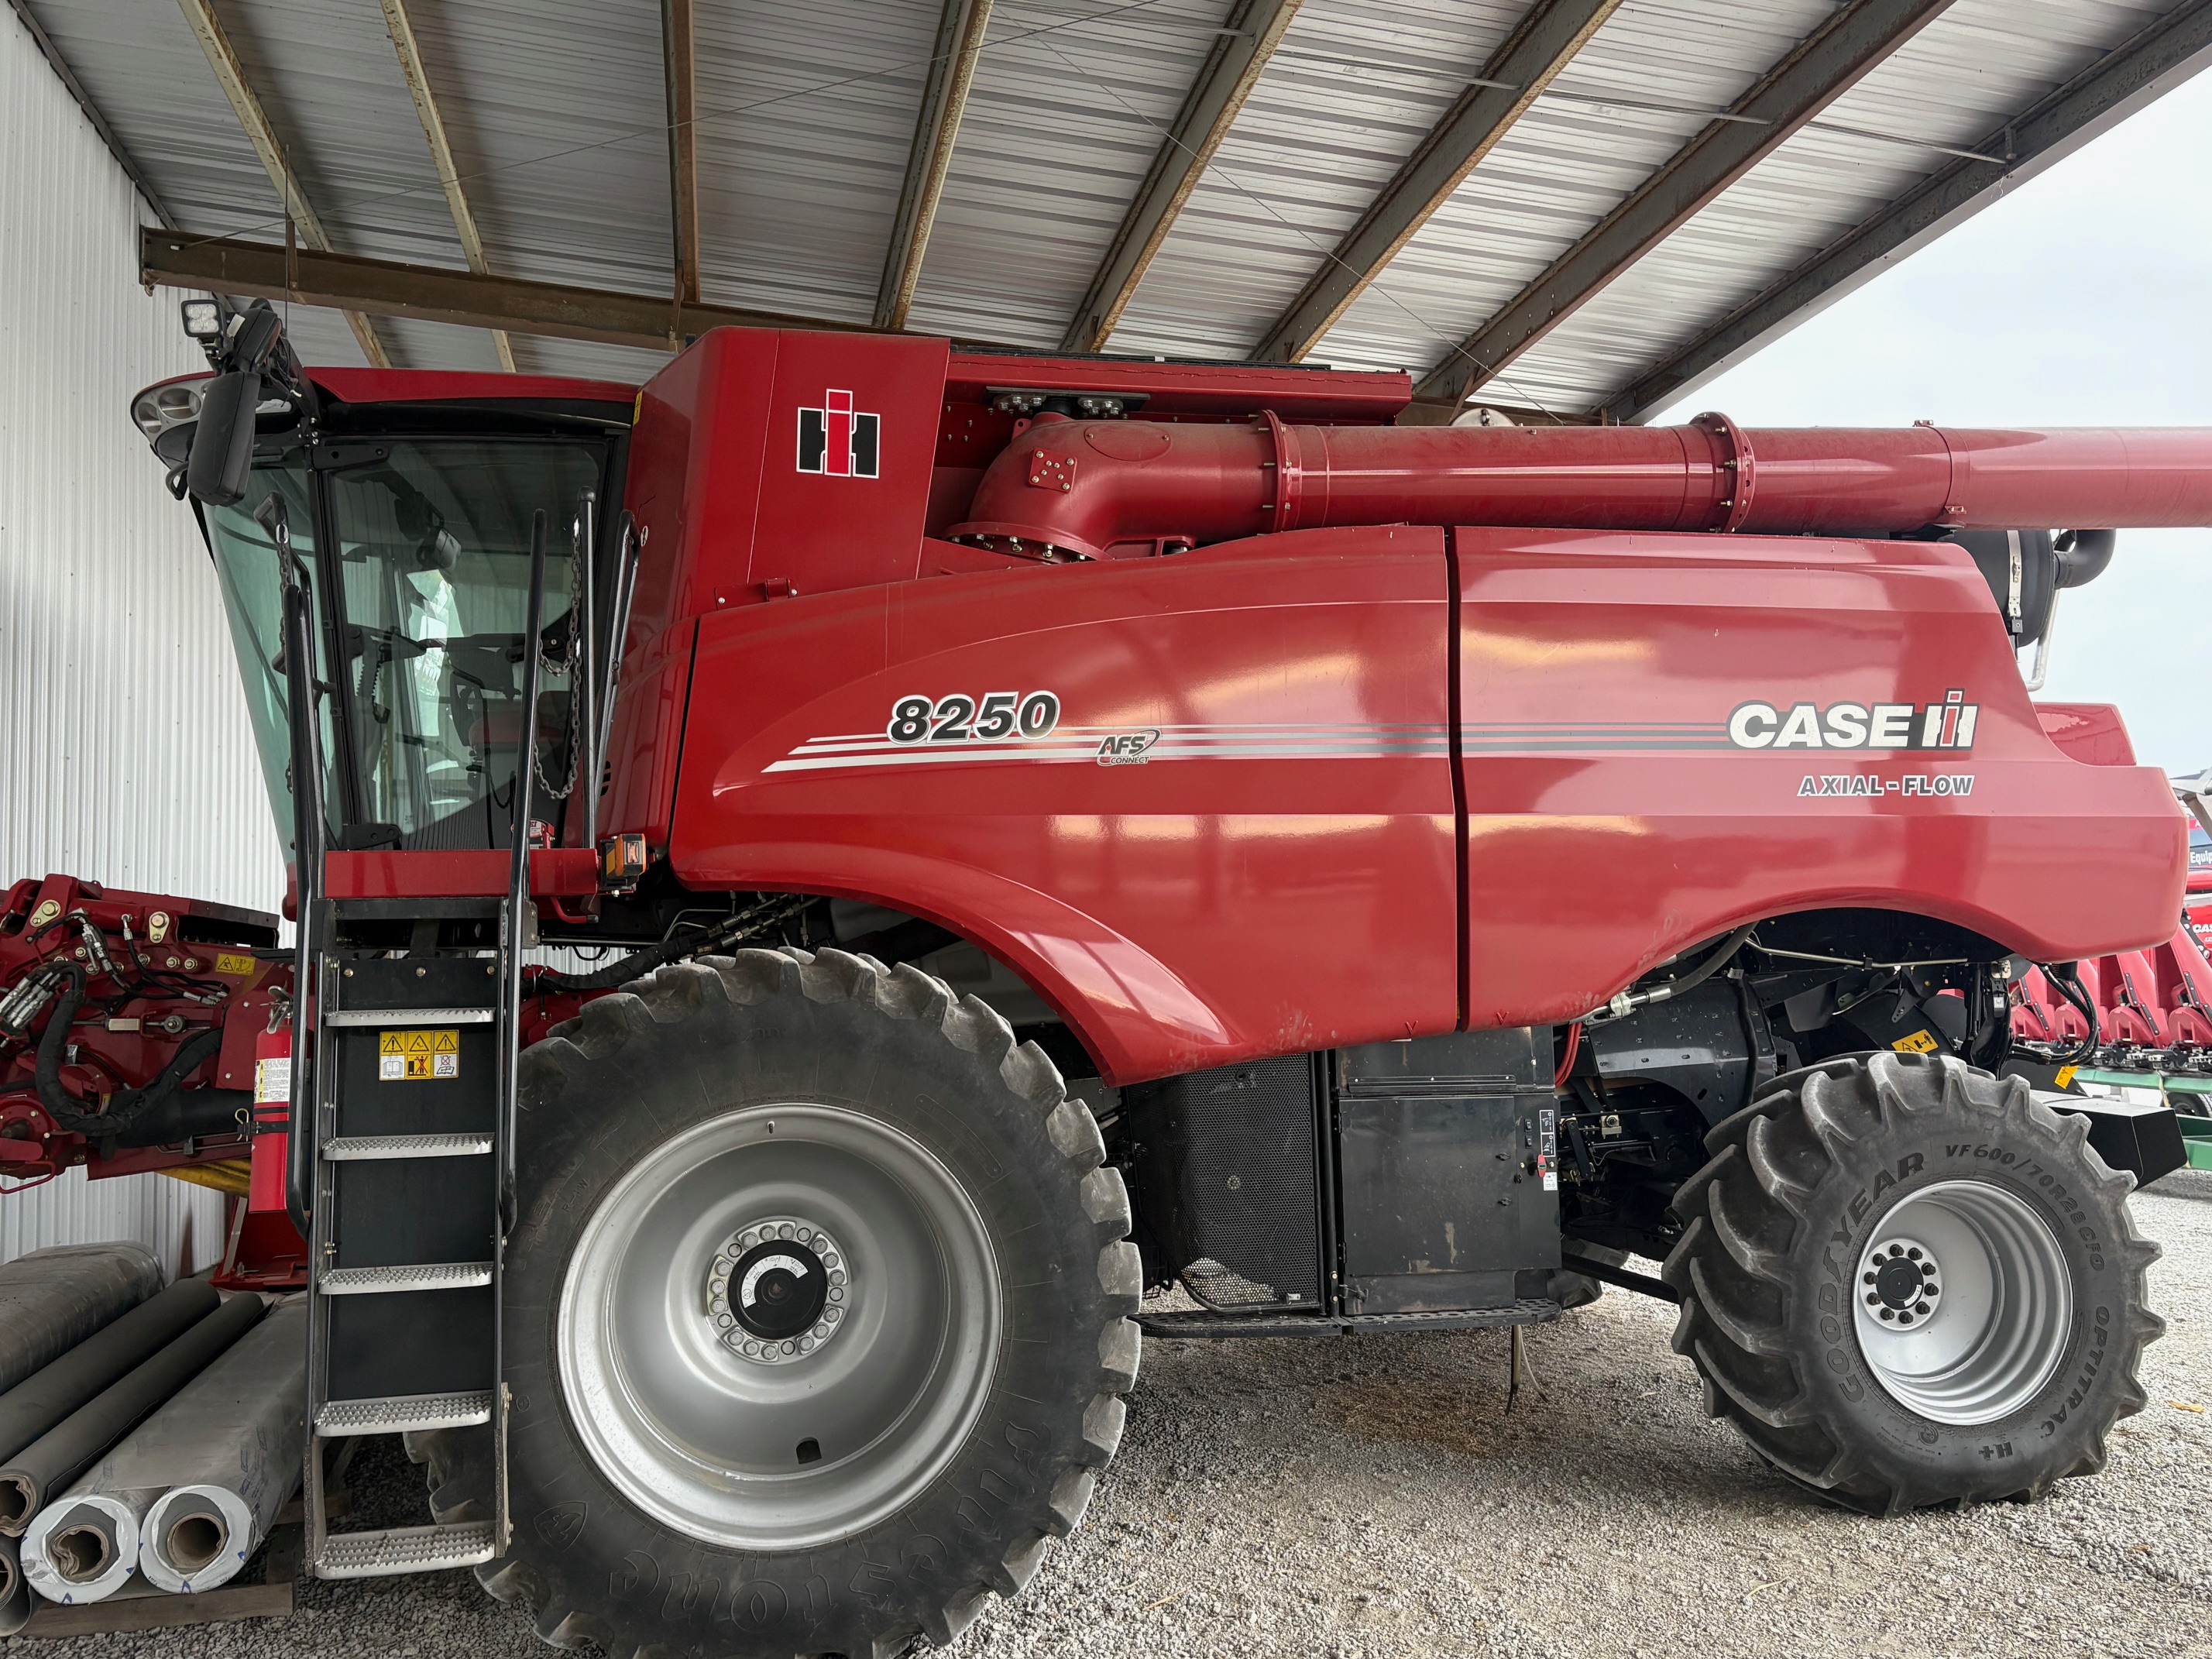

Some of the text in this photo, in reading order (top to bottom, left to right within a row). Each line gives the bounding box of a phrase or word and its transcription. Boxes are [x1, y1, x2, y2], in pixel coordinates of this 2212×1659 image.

[888, 691, 1060, 744] 8250
[1729, 703, 1914, 748] CASE
[1097, 736, 1146, 755] AFS
[1111, 756, 1149, 764] CONNECT
[1797, 775, 1974, 796] AXIAL-FLOW
[1819, 1152, 1925, 1403] GOODYEAR
[2040, 1306, 2110, 1439] OPTITRAC
